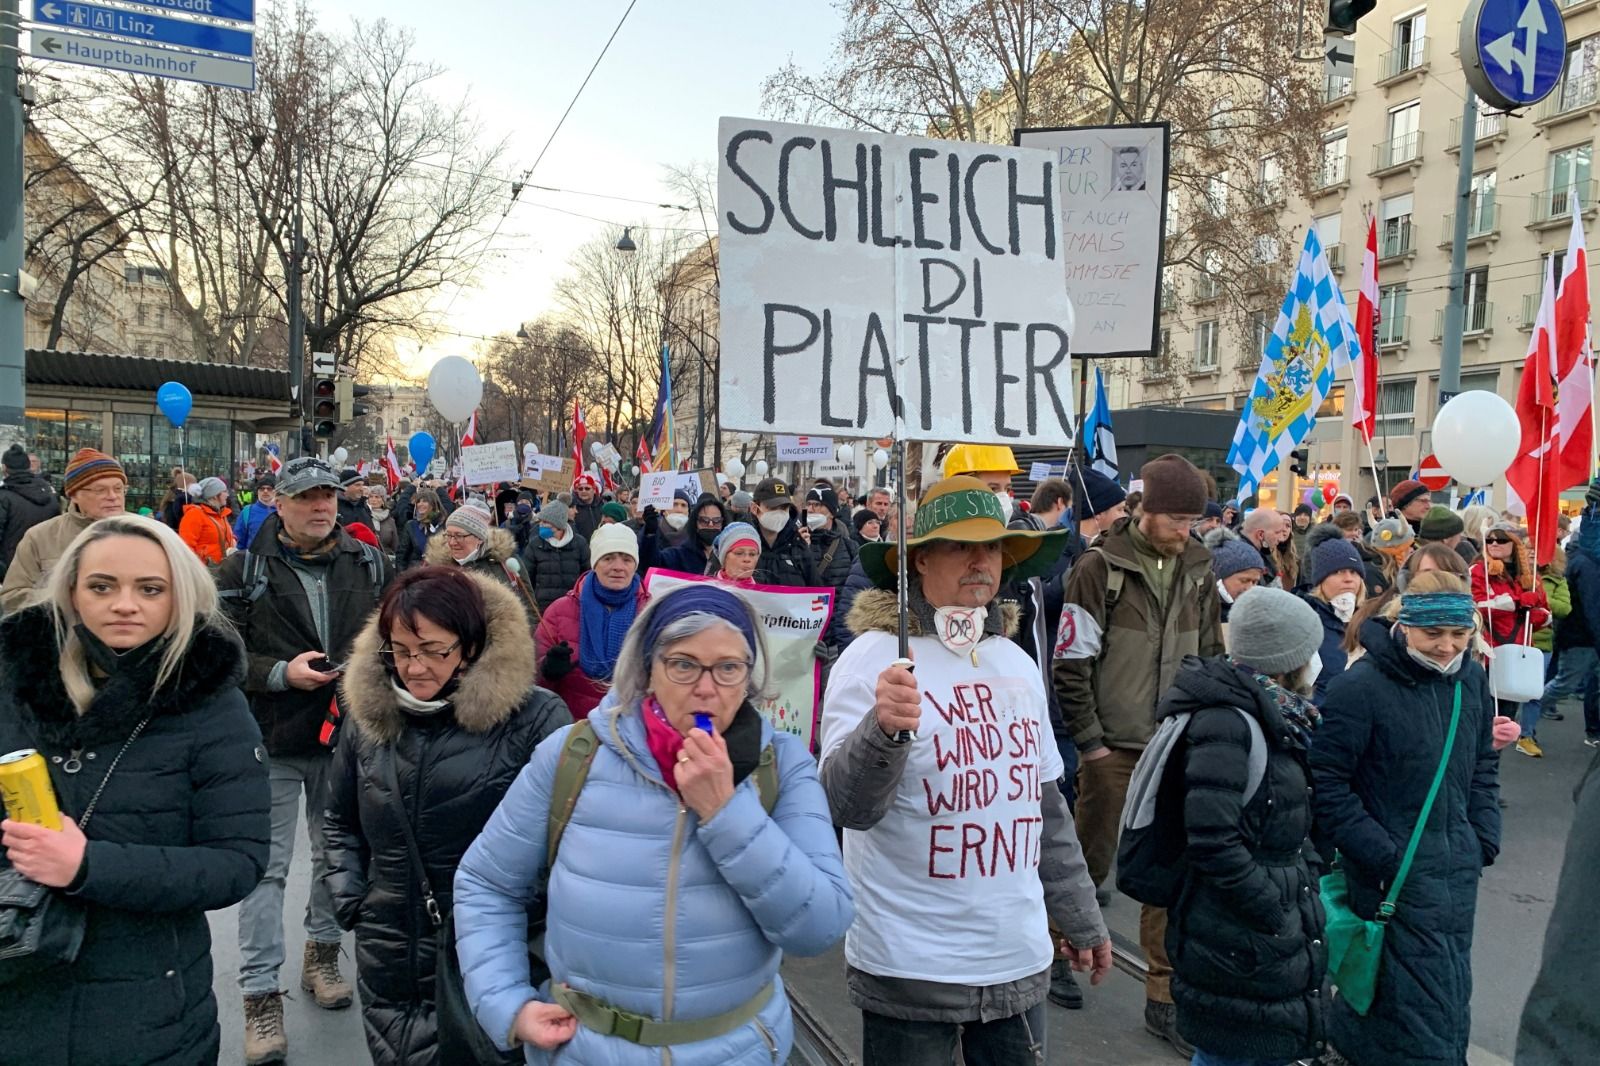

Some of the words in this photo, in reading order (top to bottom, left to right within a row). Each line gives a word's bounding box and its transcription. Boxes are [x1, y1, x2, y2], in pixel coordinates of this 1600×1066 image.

[95, 11, 112, 28] A1
[119, 15, 155, 35] Linz
[66, 40, 197, 74] Hauptbahnhof
[725, 129, 1056, 260] SCHLEICH
[1055, 170, 1098, 195] TUR
[1081, 209, 1129, 226] AUCH
[1063, 231, 1126, 253] MALS
[919, 257, 983, 318] DI
[762, 303, 1074, 439] PLATTER
[781, 446, 828, 456] UNGESPRITZT
[652, 476, 666, 487] BIO
[924, 683, 998, 726] WER
[933, 723, 1004, 772] WIND
[922, 768, 999, 816] WIRD
